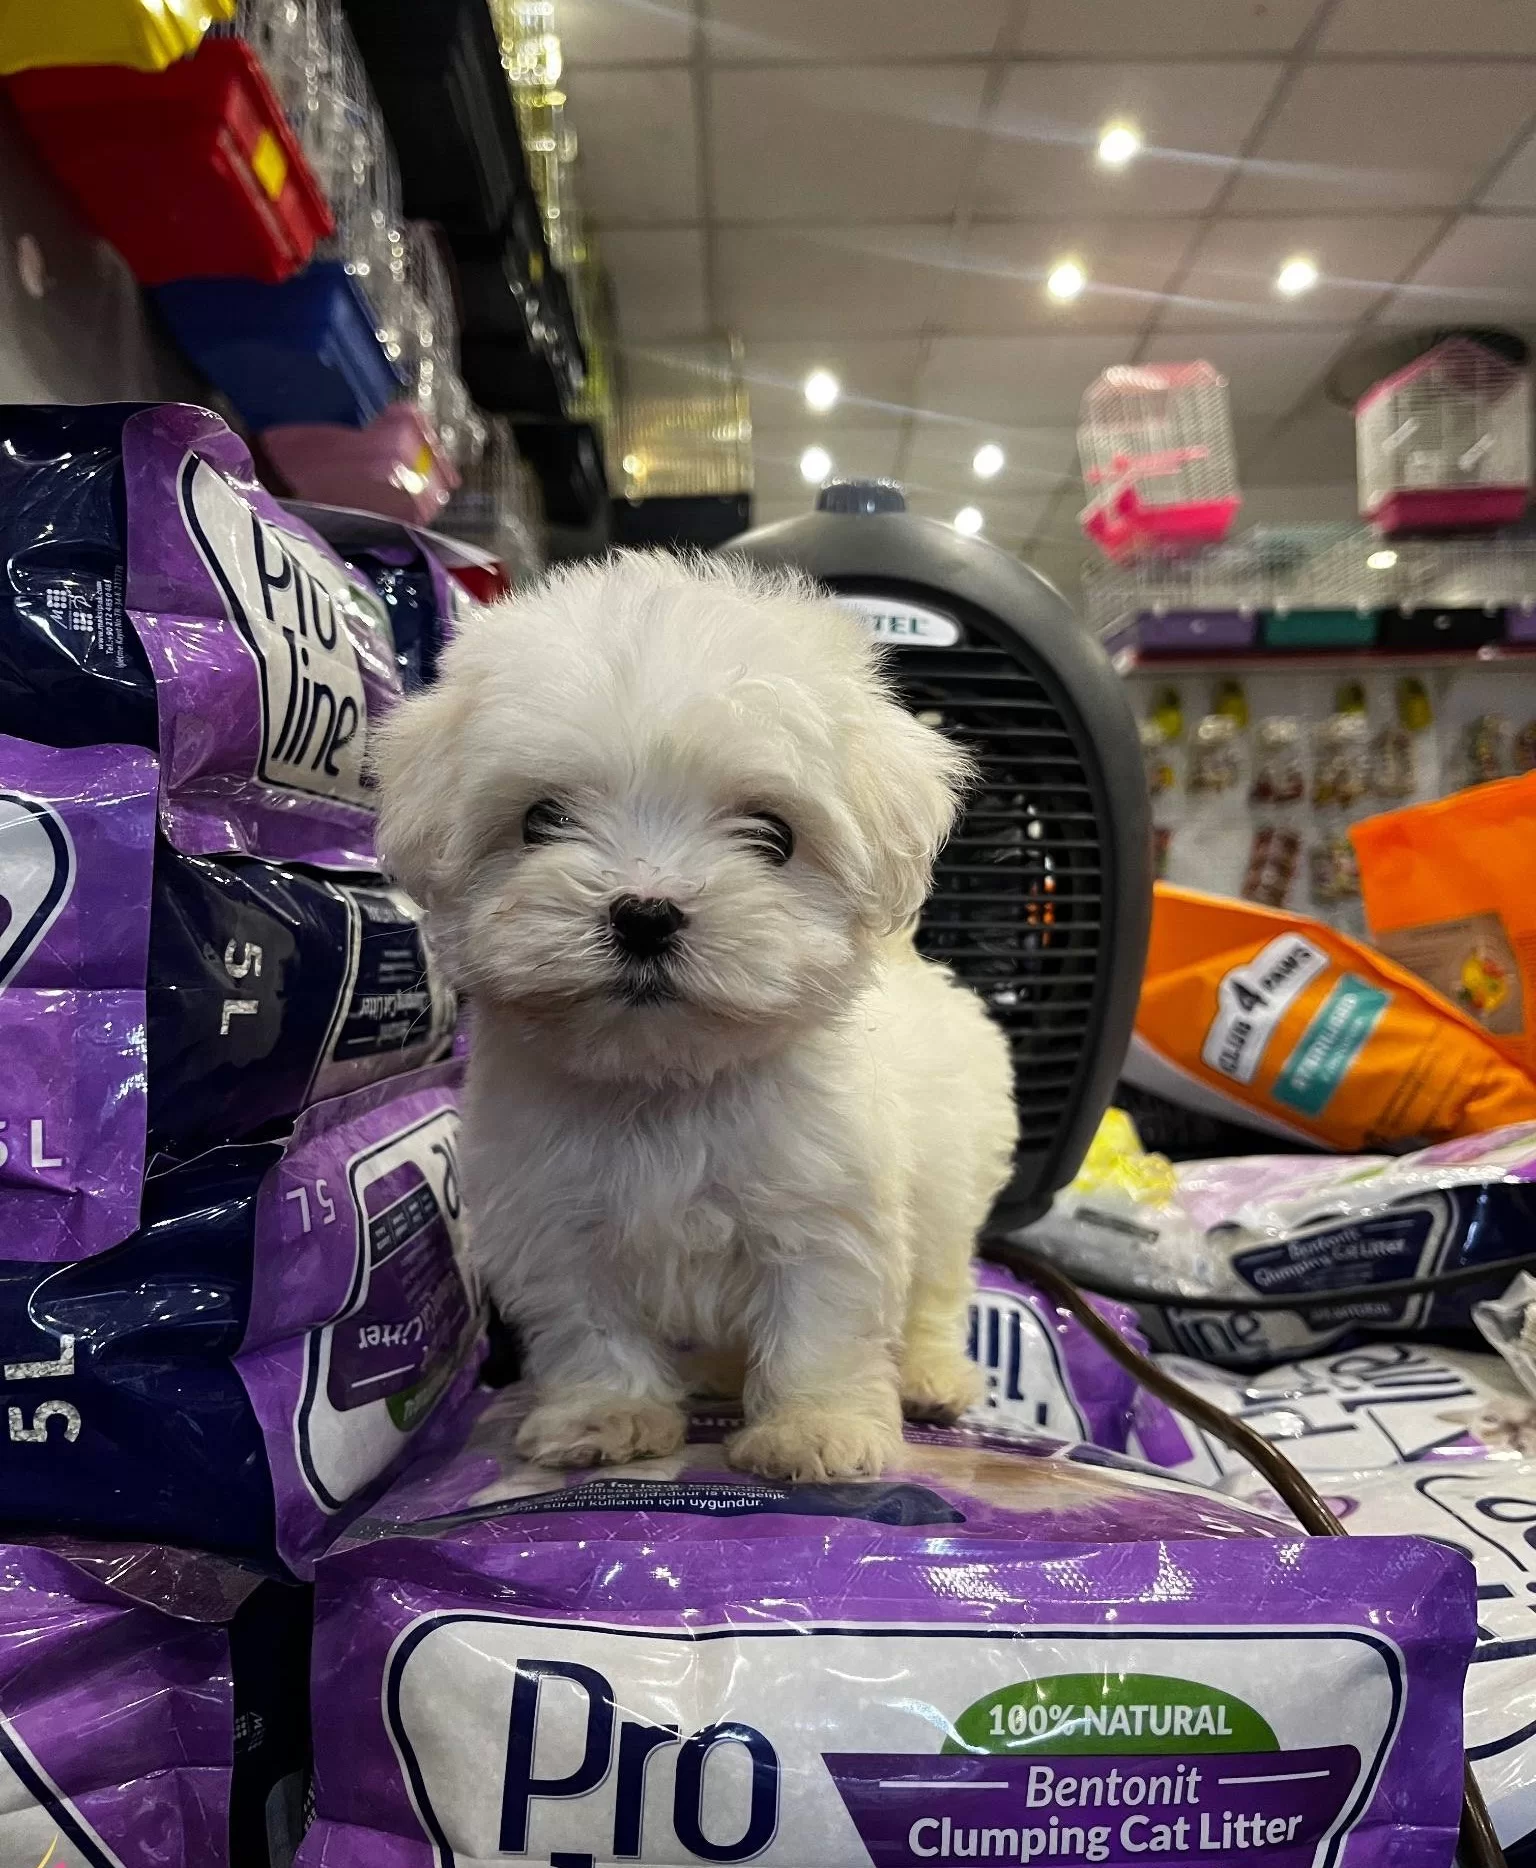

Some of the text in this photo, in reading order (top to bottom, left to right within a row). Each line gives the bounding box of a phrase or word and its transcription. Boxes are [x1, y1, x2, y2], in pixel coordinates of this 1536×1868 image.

[271, 626, 359, 776] line
[1231, 977, 1268, 1013] 4
[1218, 1021, 1252, 1074] CLUB
[358, 1316, 424, 1349] Litter
[690, 1497, 764, 1510] uygundur.
[987, 1703, 1233, 1737] 100% NATURAL
[498, 1657, 782, 1865] Pro
[1025, 1763, 1203, 1809] Bentonit
[907, 1809, 1304, 1864] Clumping Cat Litter
